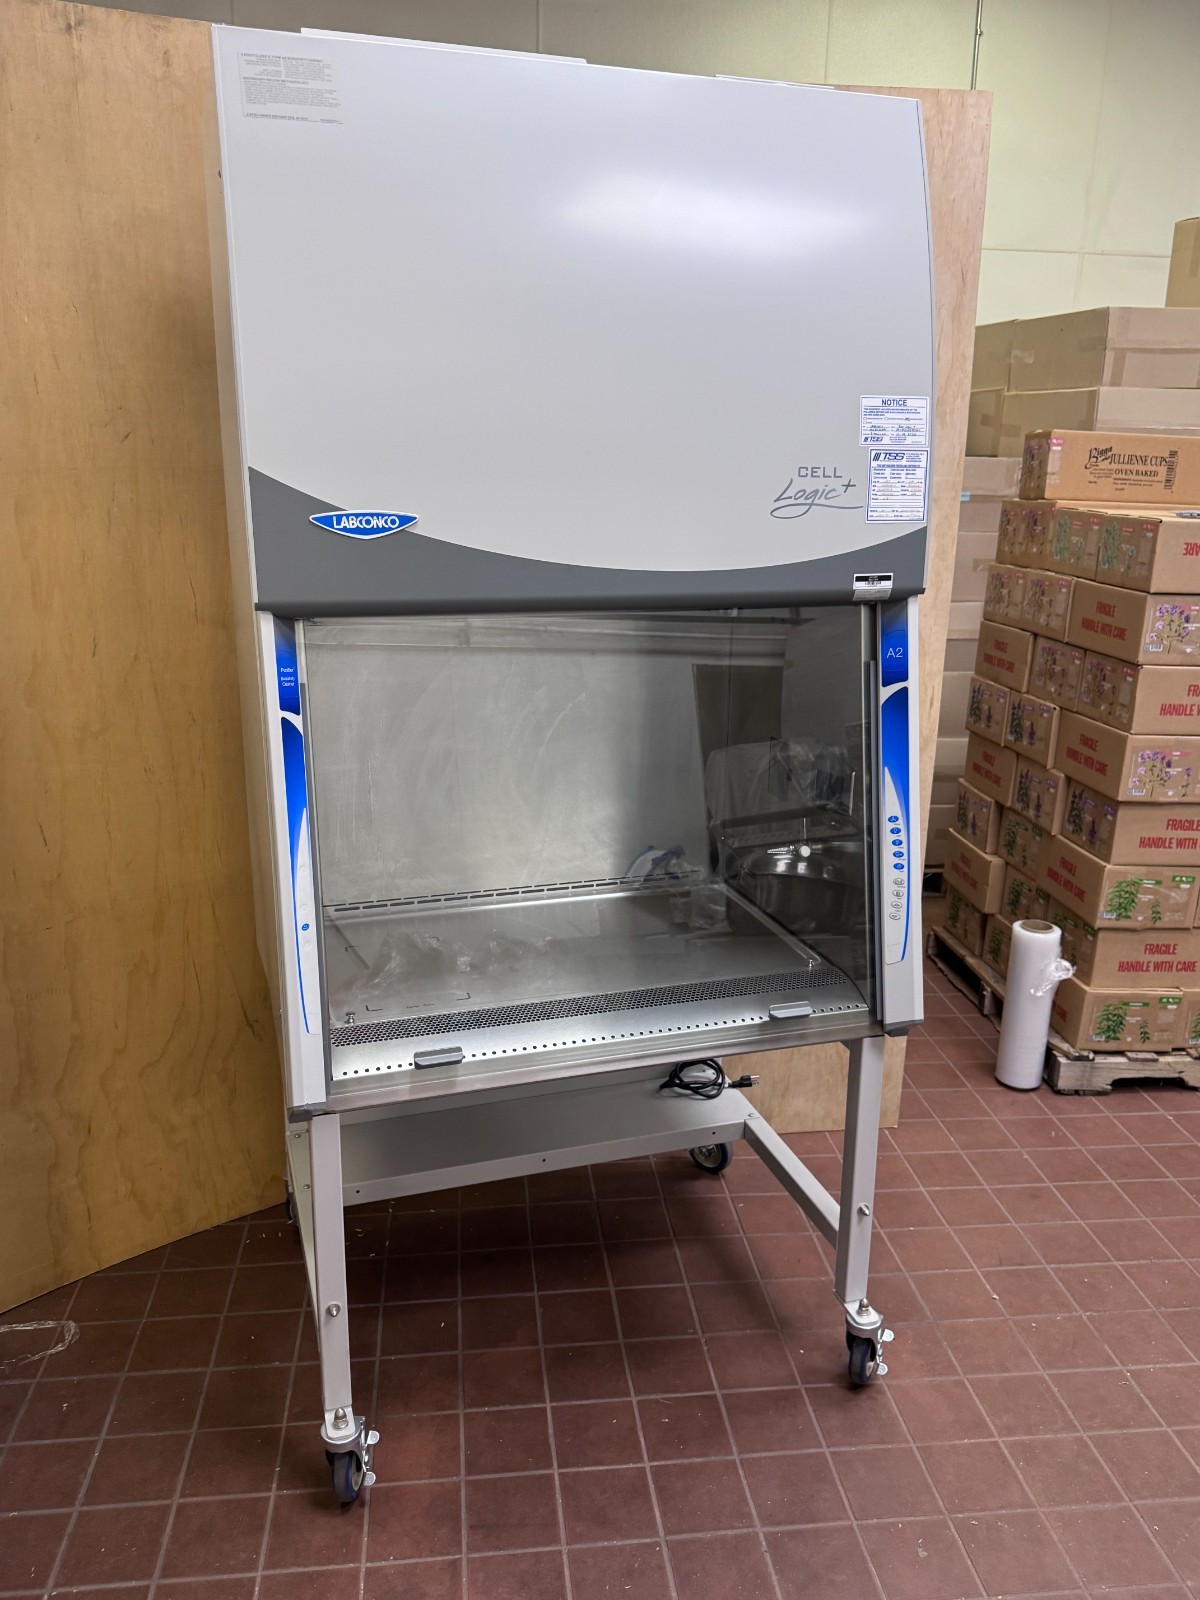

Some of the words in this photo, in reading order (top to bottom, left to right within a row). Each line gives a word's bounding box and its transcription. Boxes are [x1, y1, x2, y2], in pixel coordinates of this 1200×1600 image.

[881, 399, 908, 407] NOTICE
[882, 452, 906, 461] TSS
[1109, 453, 1149, 466] JULLIENNE
[1149, 455, 1168, 467] CUPS
[798, 466, 843, 478] CELL
[1114, 468, 1135, 476] OVEN
[333, 515, 400, 528] LABCONCO
[886, 648, 903, 659] A2
[1160, 703, 1196, 716] HANDLE
[1166, 818, 1200, 831] FRAGILE
[1139, 836, 1174, 849] HANDLE
[1175, 837, 1198, 850] WITH
[1144, 943, 1178, 955] FRAGILE
[1118, 960, 1151, 972] HANDLE
[1152, 960, 1174, 972] WITH
[1175, 960, 1198, 973] CARE
